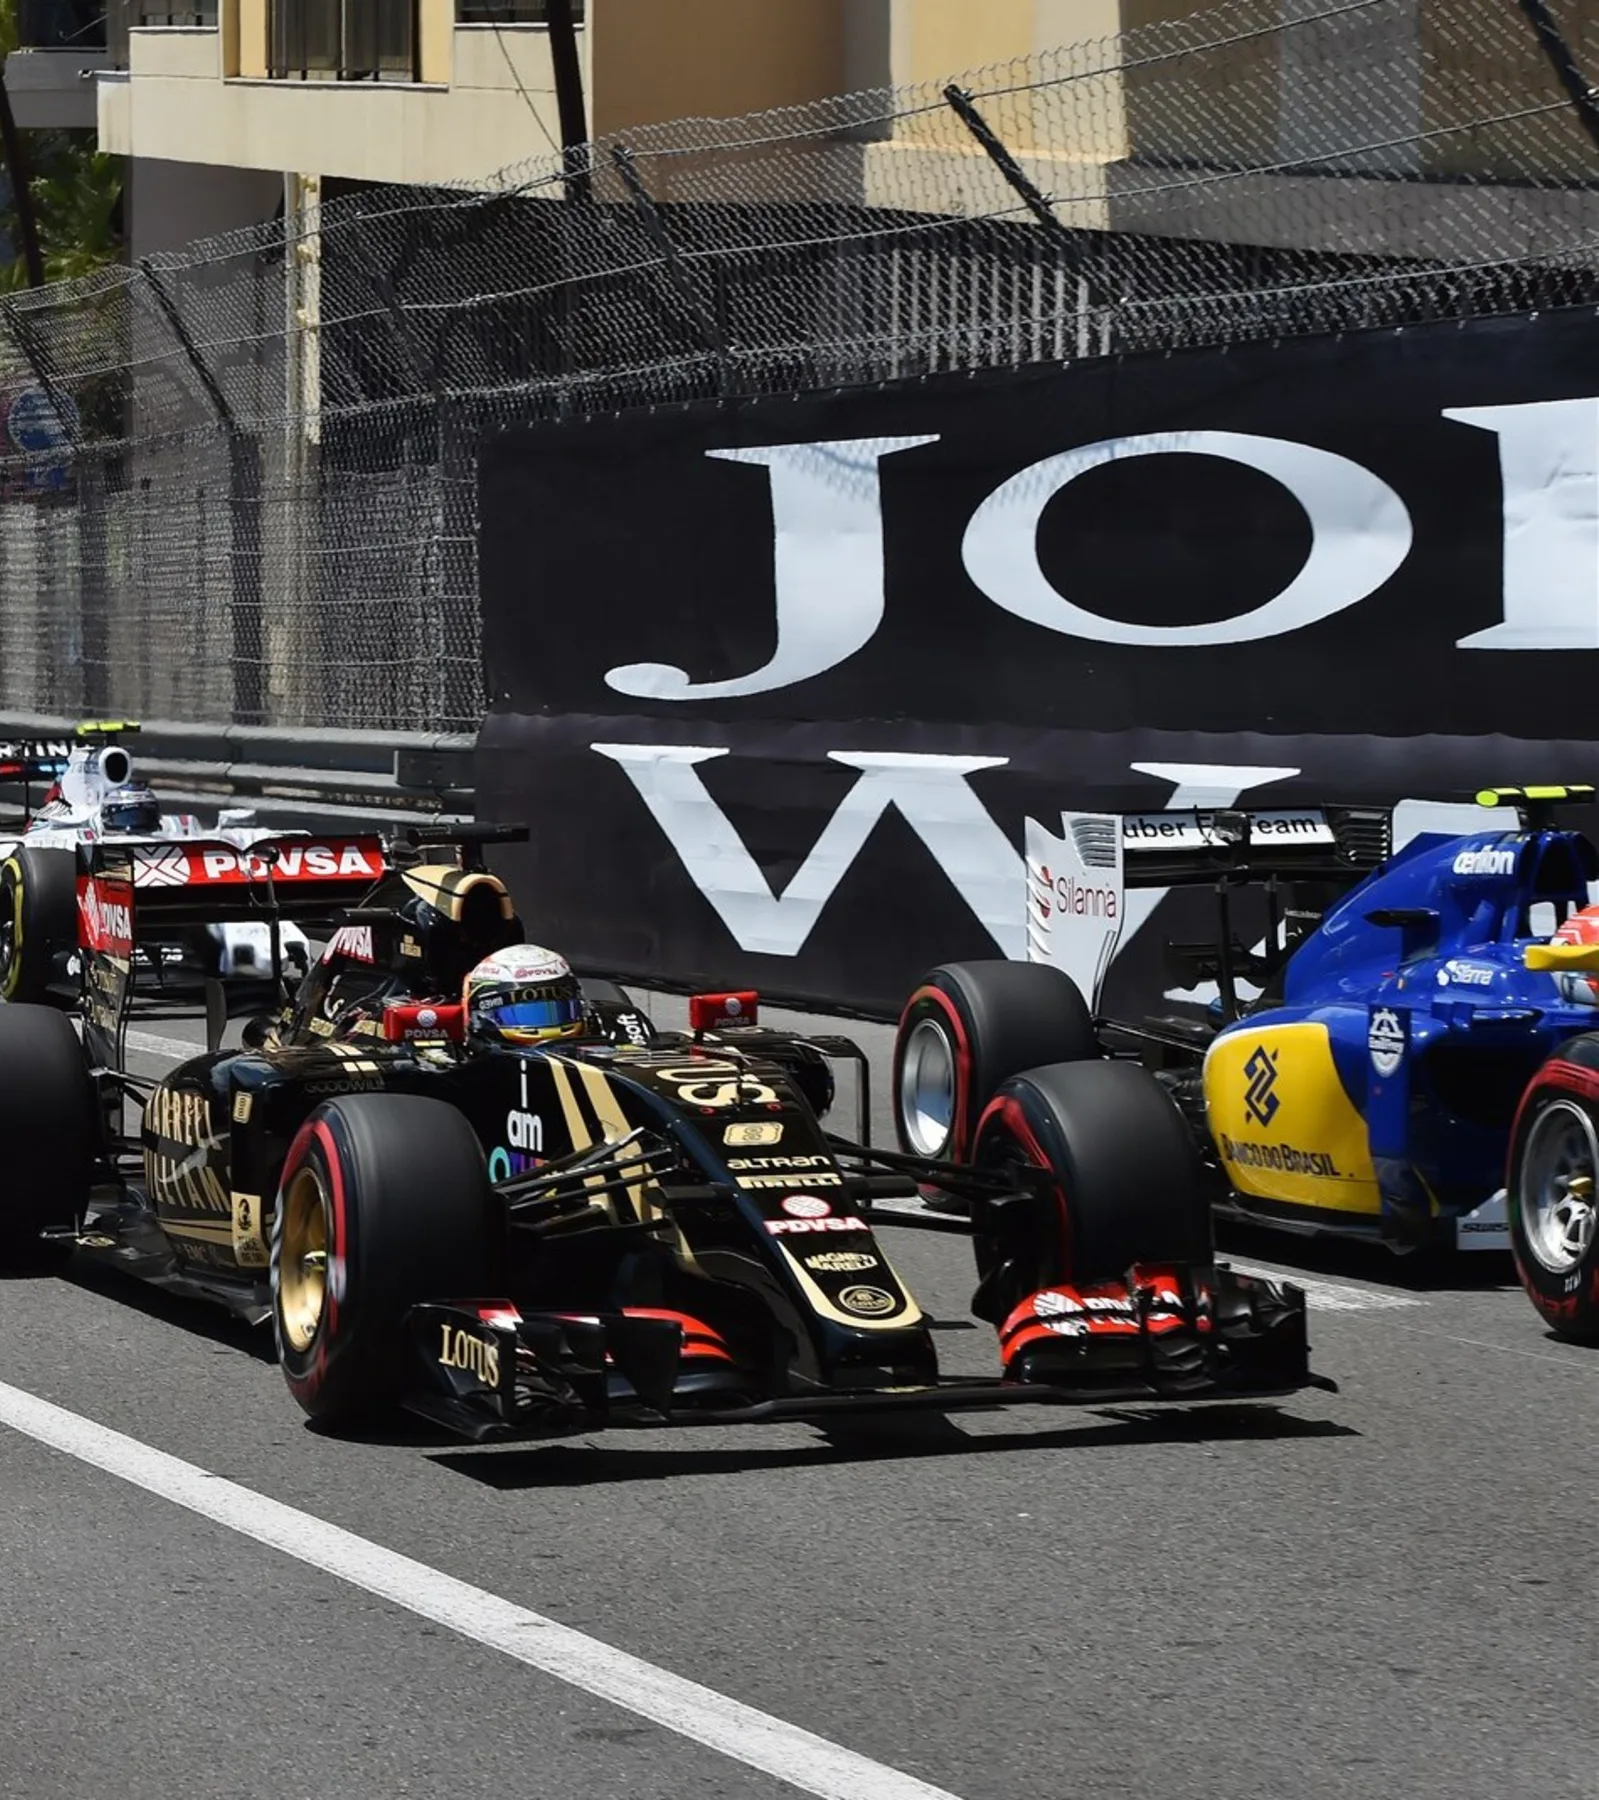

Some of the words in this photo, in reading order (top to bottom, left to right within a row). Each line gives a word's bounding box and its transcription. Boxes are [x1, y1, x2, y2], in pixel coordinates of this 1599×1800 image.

[1123, 818, 1187, 839] uber
[1057, 876, 1117, 919] Silanna
[509, 985, 572, 1003] LOTUS
[507, 1109, 542, 1152] am
[1280, 1143, 1341, 1176] BRASIL
[735, 1173, 843, 1190] PIRELLI
[764, 1216, 870, 1235] PDVSA
[439, 1325, 499, 1388] LOTUS
